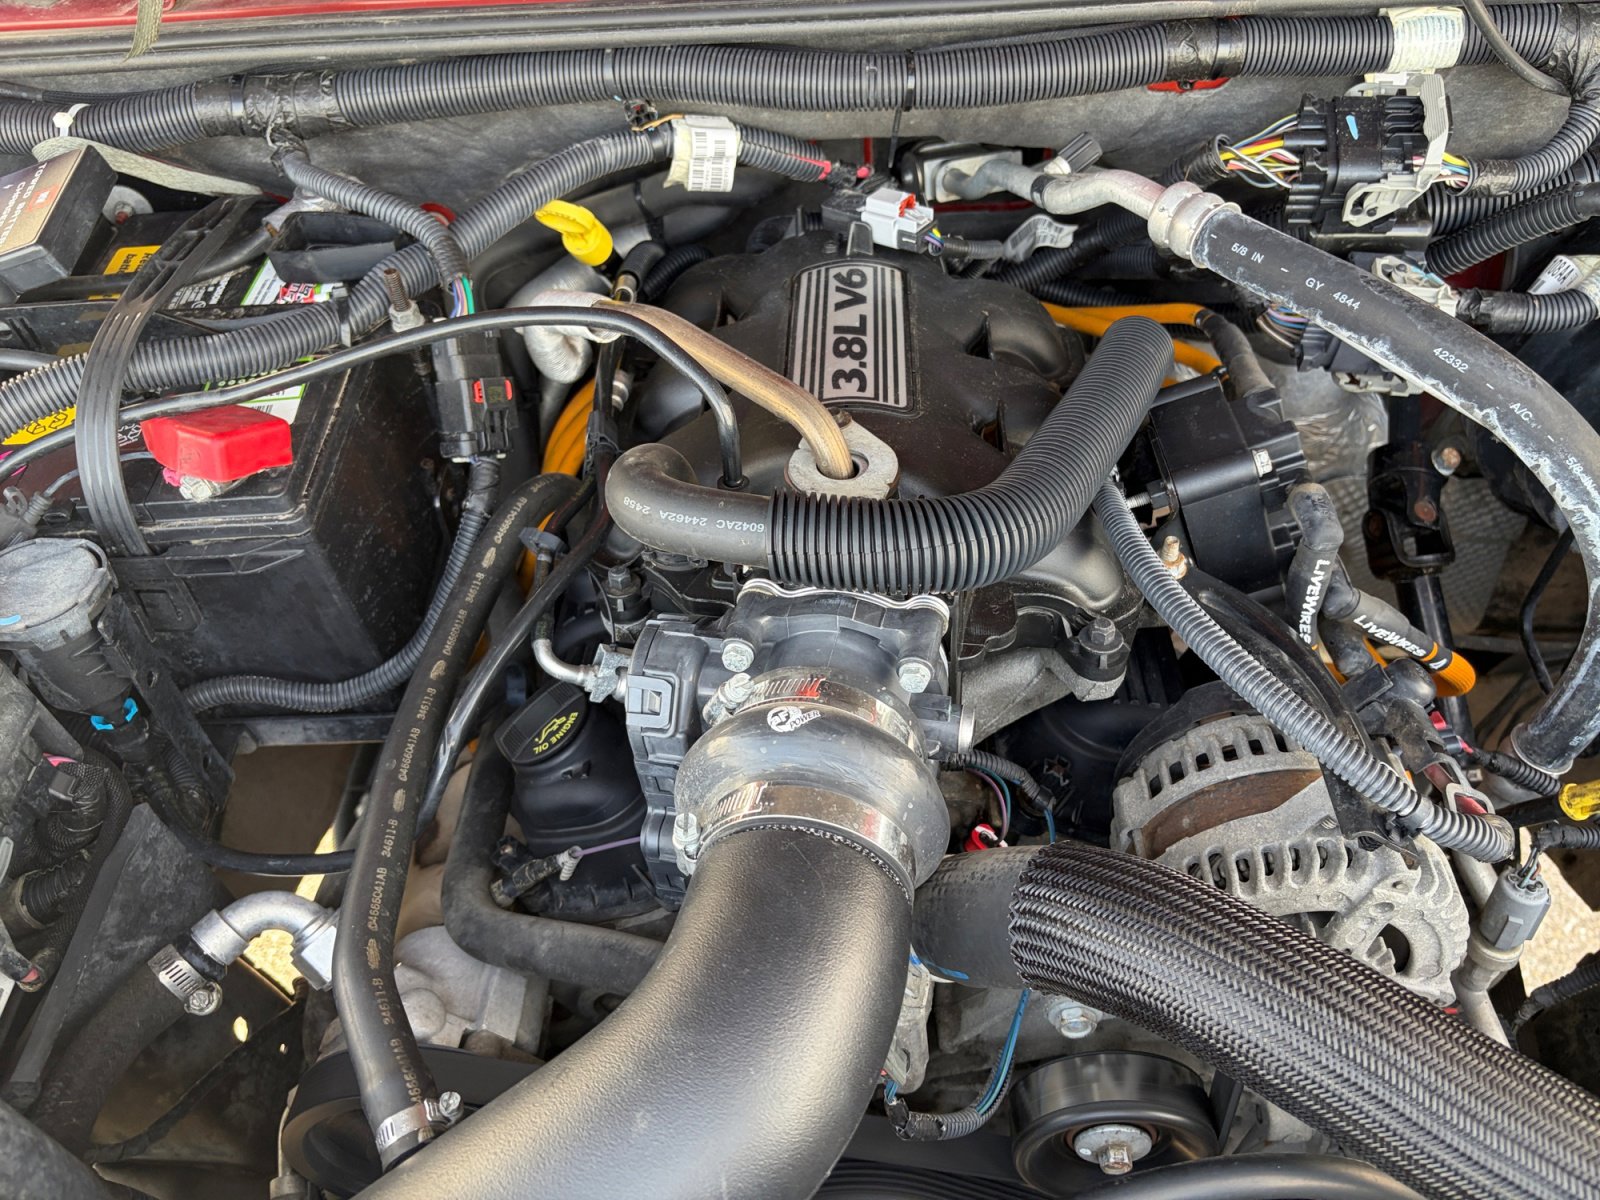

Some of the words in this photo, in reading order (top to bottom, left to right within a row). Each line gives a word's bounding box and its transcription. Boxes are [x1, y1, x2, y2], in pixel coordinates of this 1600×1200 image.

[23, 162, 47, 198] TOWED
[833, 268, 867, 312] V6
[1231, 242, 1247, 257] 5/8
[1250, 251, 1265, 264] IN
[1305, 277, 1325, 291] GY
[1332, 290, 1361, 311] 4844
[1432, 347, 1469, 374] 42332
[831, 313, 867, 393] 3.8L
[623, 496, 651, 515] 2458
[659, 510, 708, 526] 24462A
[716, 519, 765, 533] 6042AC
[550, 711, 579, 744] ENGINE
[790, 710, 821, 730] POWER
[532, 742, 549, 755] OIL
